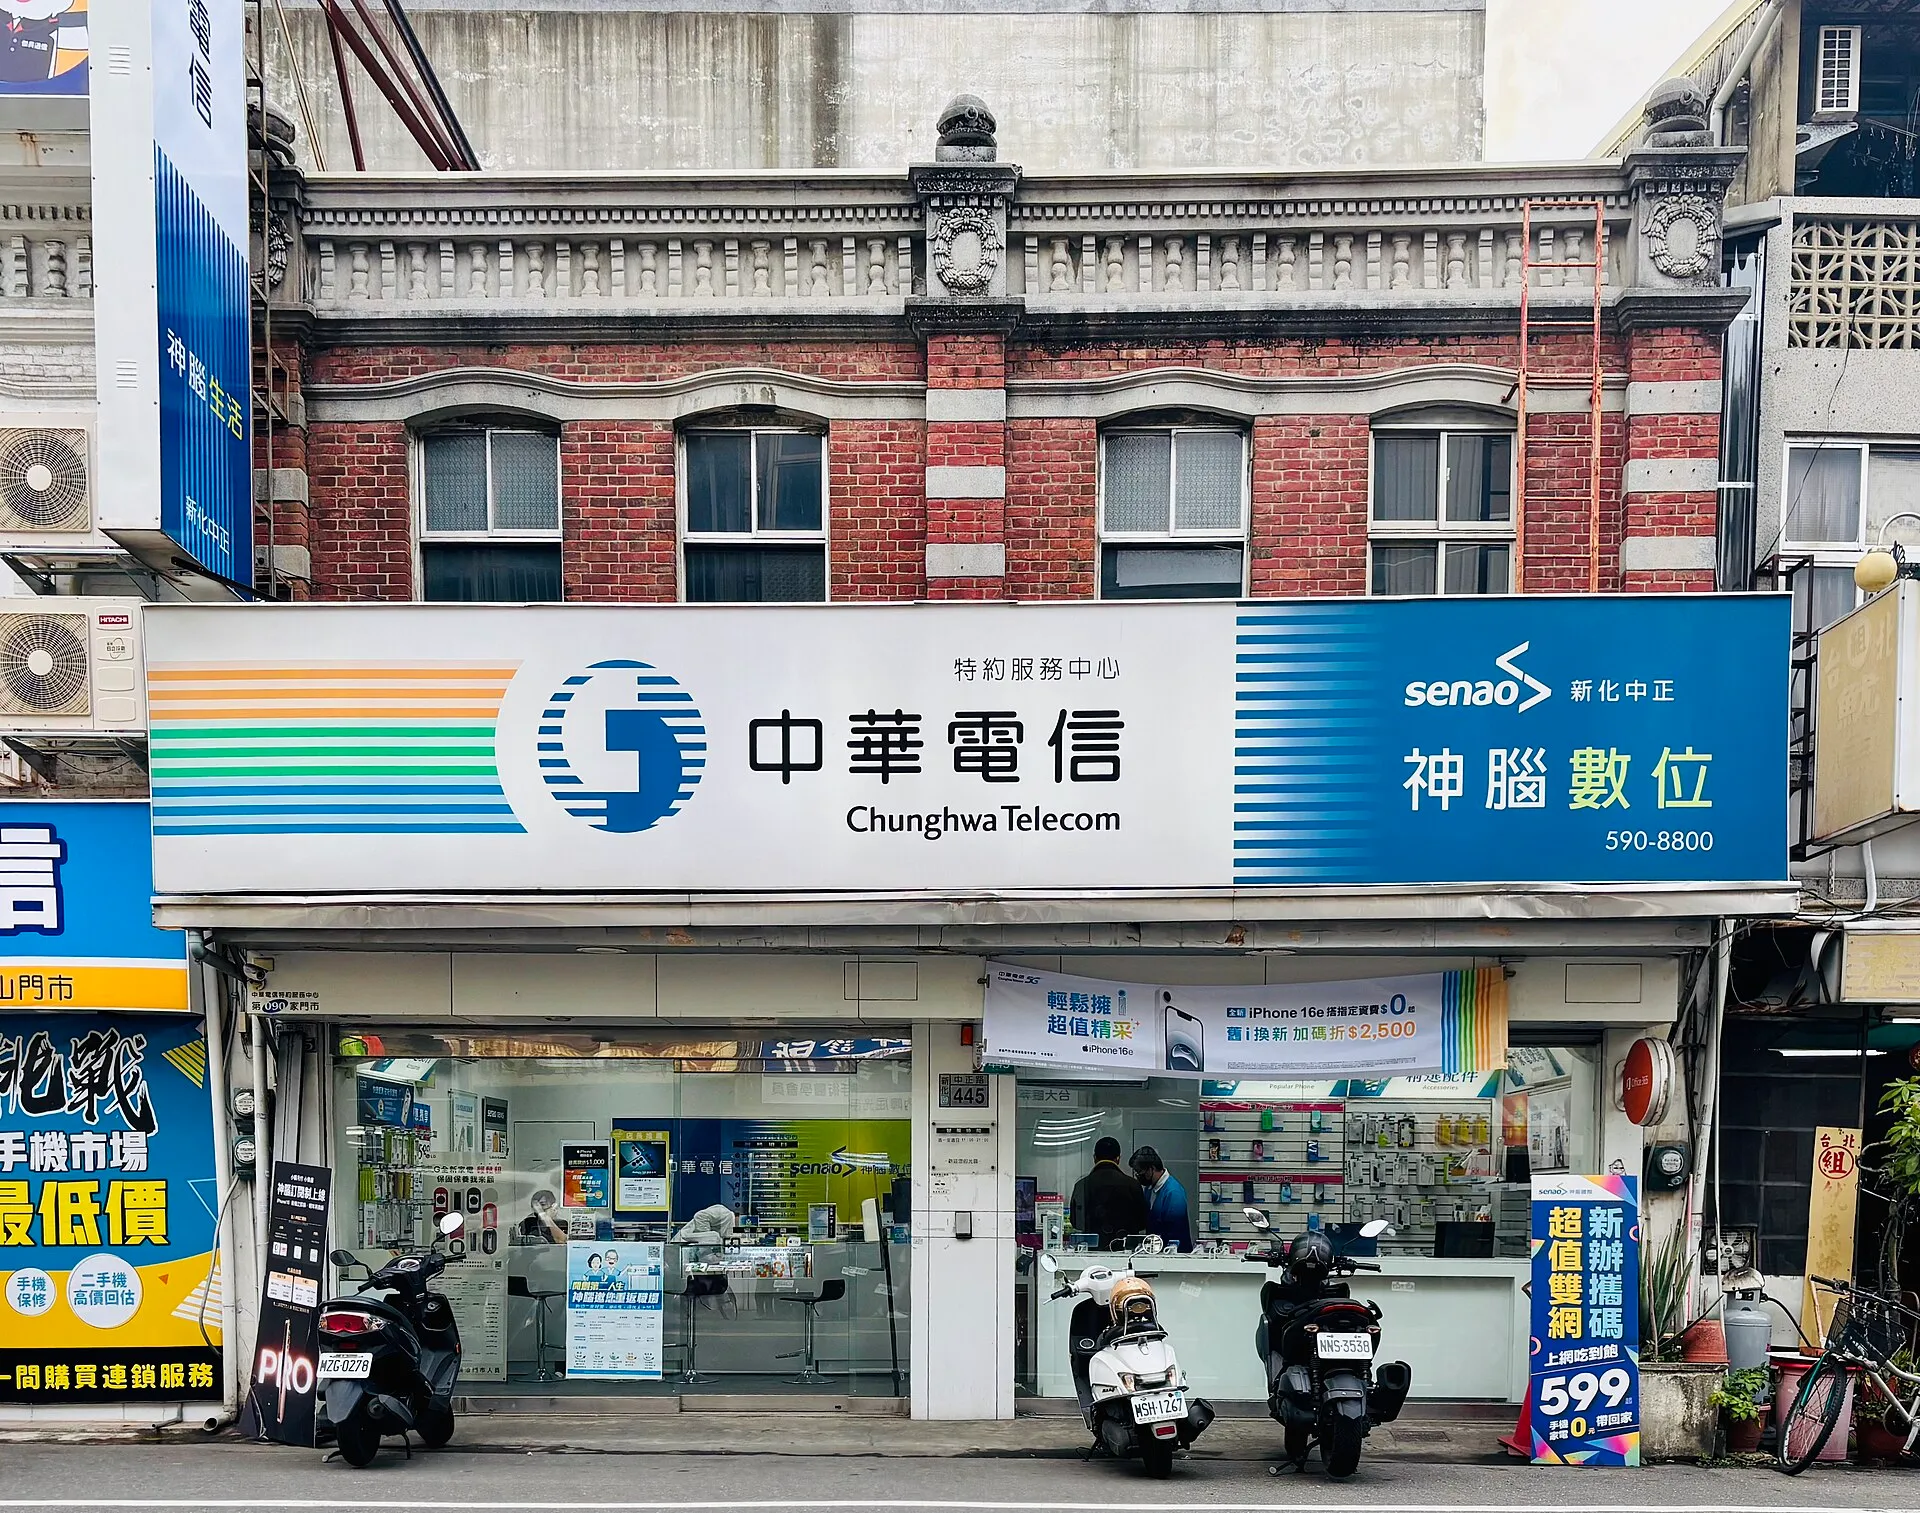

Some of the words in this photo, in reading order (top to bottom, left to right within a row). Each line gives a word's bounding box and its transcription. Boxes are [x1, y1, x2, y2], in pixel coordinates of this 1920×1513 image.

[166, 328, 244, 440] 神腦生活
[185, 495, 230, 556] 新化中正
[954, 657, 1120, 682] 特約服務中心
[1404, 679, 1519, 707] senao
[1570, 679, 1675, 702] 新化中正
[749, 709, 1125, 785] 中華電信
[1402, 746, 1713, 811] 神腦數位
[846, 805, 997, 840] Chunghwa
[1001, 805, 1121, 832] Telecom
[1604, 830, 1714, 851] 590-8800
[251, 1001, 320, 1011] 第090家門市
[1249, 1009, 1297, 1019] iPhone
[1301, 1007, 1324, 1018] 16e
[1047, 1014, 1133, 1040] 超值精采
[1089, 1044, 1118, 1054] iPhone
[1119, 1046, 1134, 1056] 16e
[953, 1075, 985, 1085] 中正路
[1269, 1083, 1299, 1091] Popular
[953, 1087, 985, 1104] 445
[1820, 1133, 1855, 1148] 台北
[0, 1131, 148, 1172] 手機市場
[790, 1163, 842, 1175] senao
[1822, 1151, 1846, 1174] 組
[0, 1180, 169, 1246] 最低價
[81, 1272, 128, 1289] 二手機
[1547, 1206, 1583, 1339] 超值雙網
[1588, 1206, 1624, 1340] 新辦攜碼
[17, 1276, 46, 1291] 手機
[17, 1292, 46, 1308] 保修
[73, 1289, 136, 1307] 高價回估
[1319, 1339, 1370, 1353] NNS-3538
[1543, 1343, 1619, 1368] 上網吃到飽
[257, 1347, 314, 1395] PRO
[319, 1359, 370, 1372] MZG-0278
[1539, 1368, 1631, 1416] 599
[1134, 1398, 1184, 1418] MSH-1267
[1549, 1419, 1569, 1431] 手機
[1596, 1411, 1633, 1427] 帶回家
[1549, 1430, 1569, 1441] 家電
